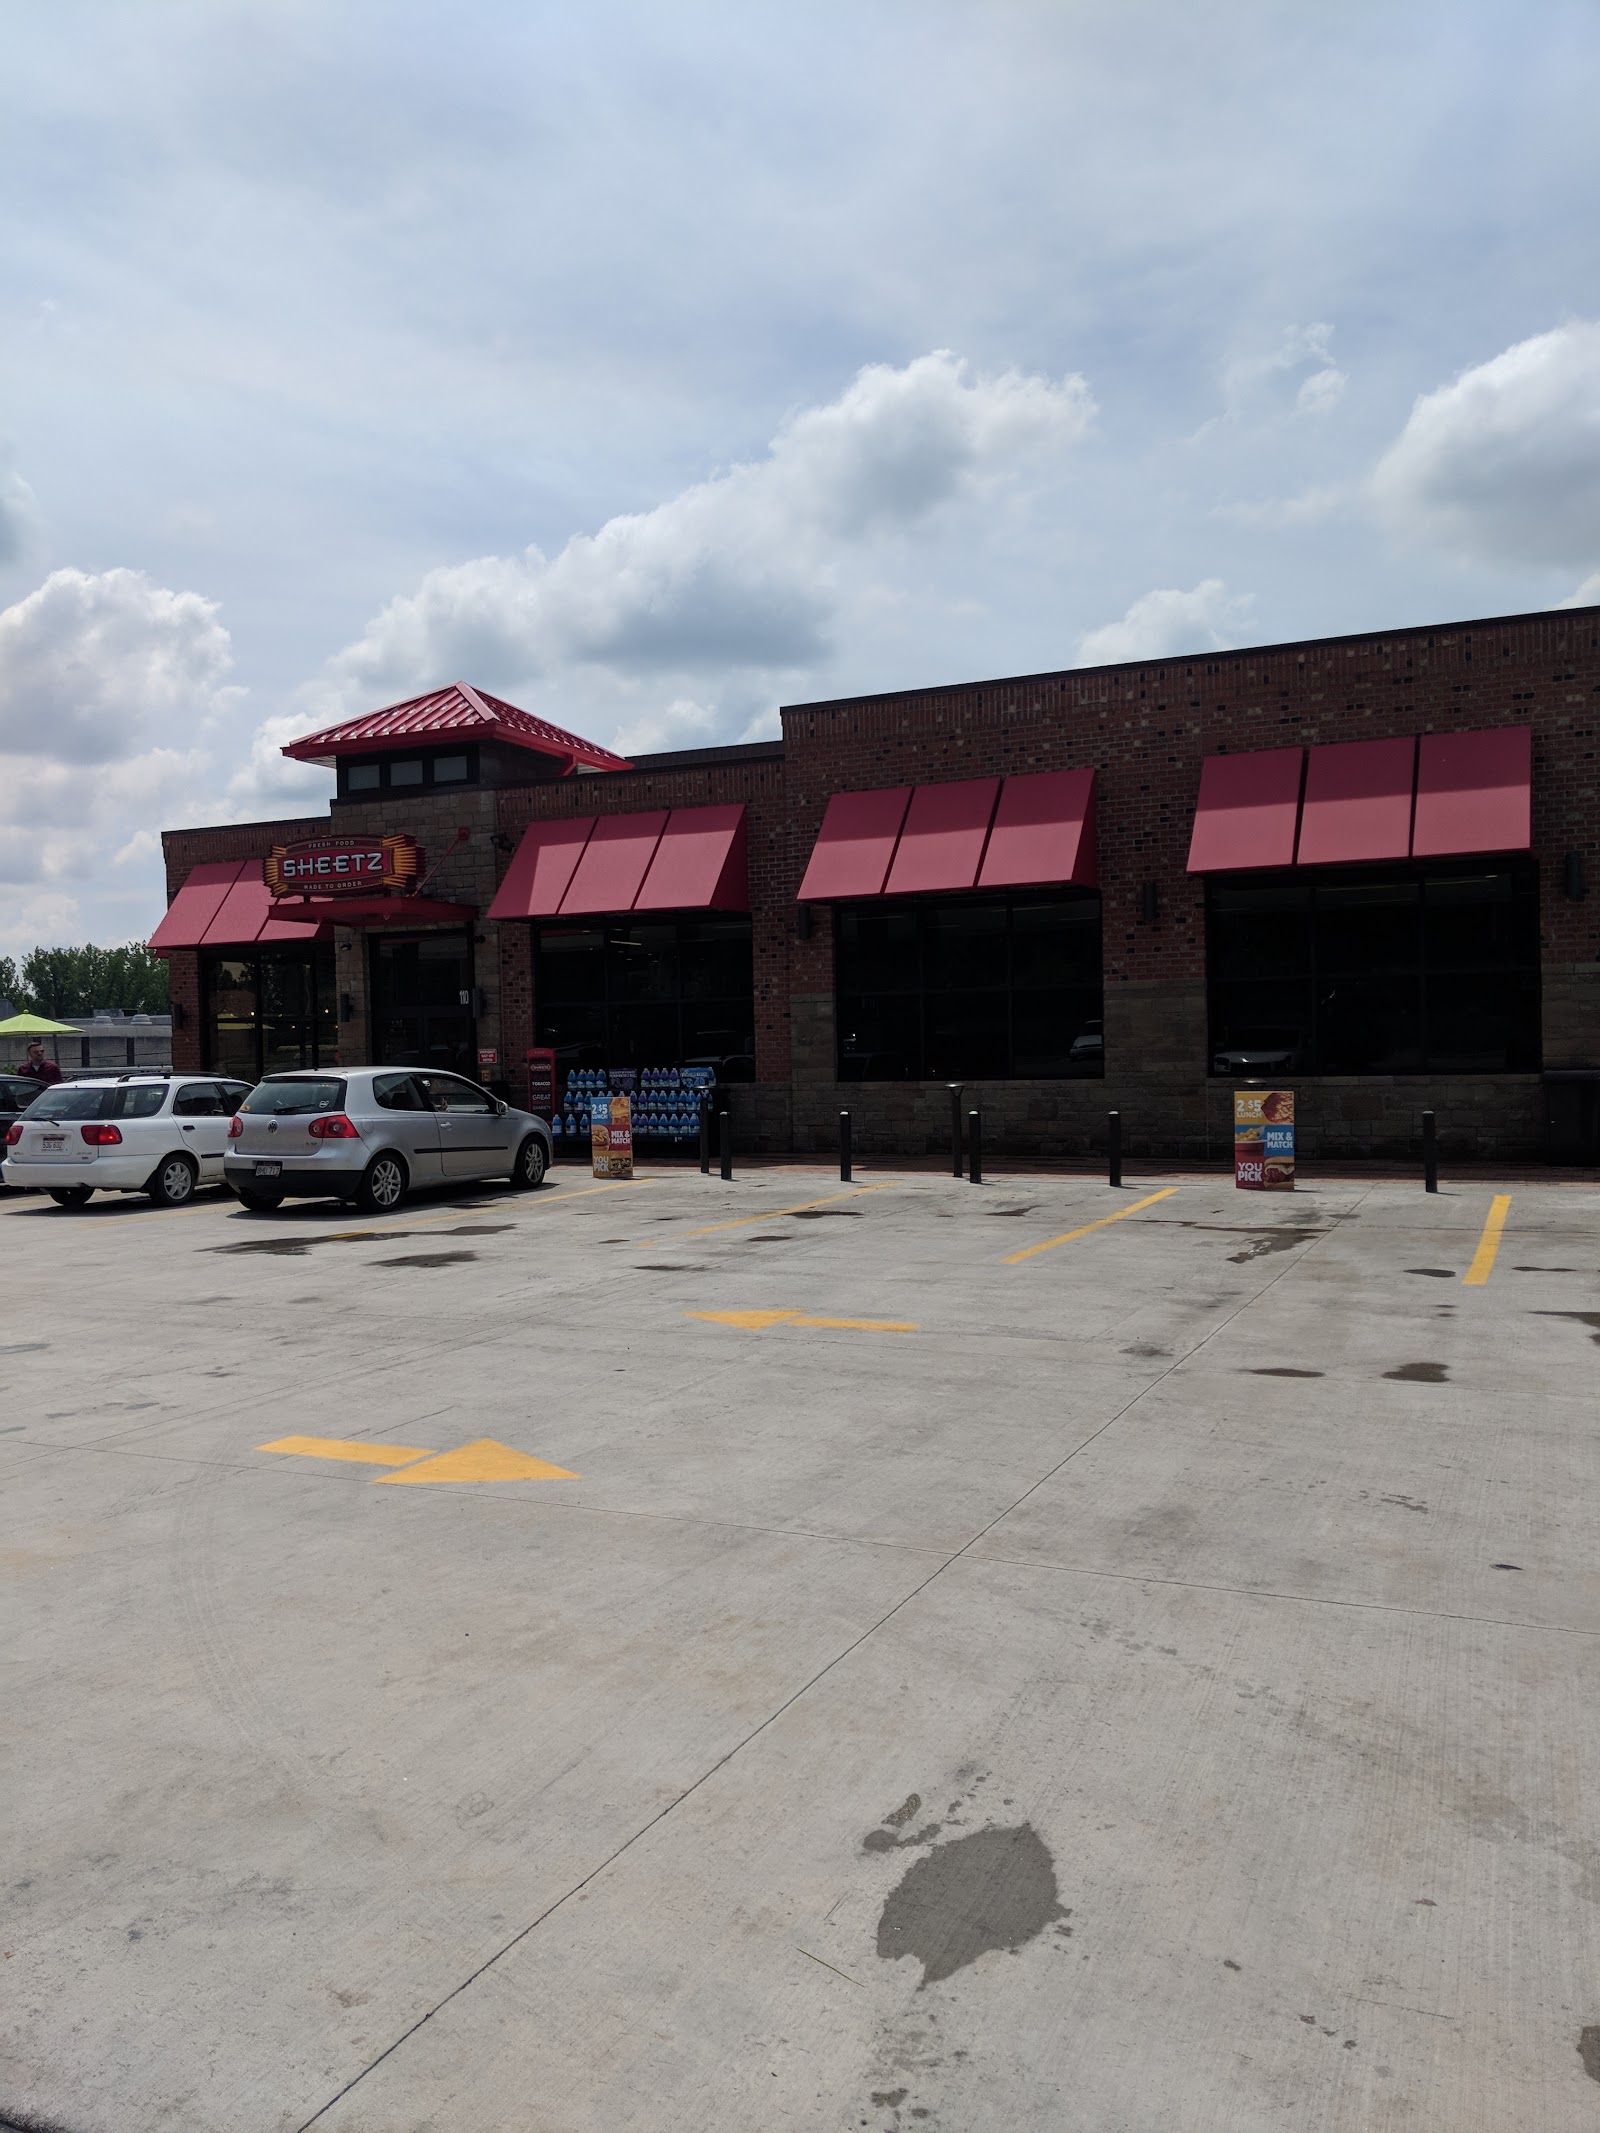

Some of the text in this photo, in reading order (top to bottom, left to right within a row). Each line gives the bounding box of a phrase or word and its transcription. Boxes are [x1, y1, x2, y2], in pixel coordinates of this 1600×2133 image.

[283, 852, 383, 877] SHEETZ
[592, 1104, 608, 1114] 2 $5
[1236, 1100, 1262, 1112] 2 $5
[1267, 1132, 1293, 1140] MIX &
[594, 1163, 608, 1172] PICK
[1238, 1162, 1263, 1171] YOU
[1238, 1172, 1262, 1182] PICK
